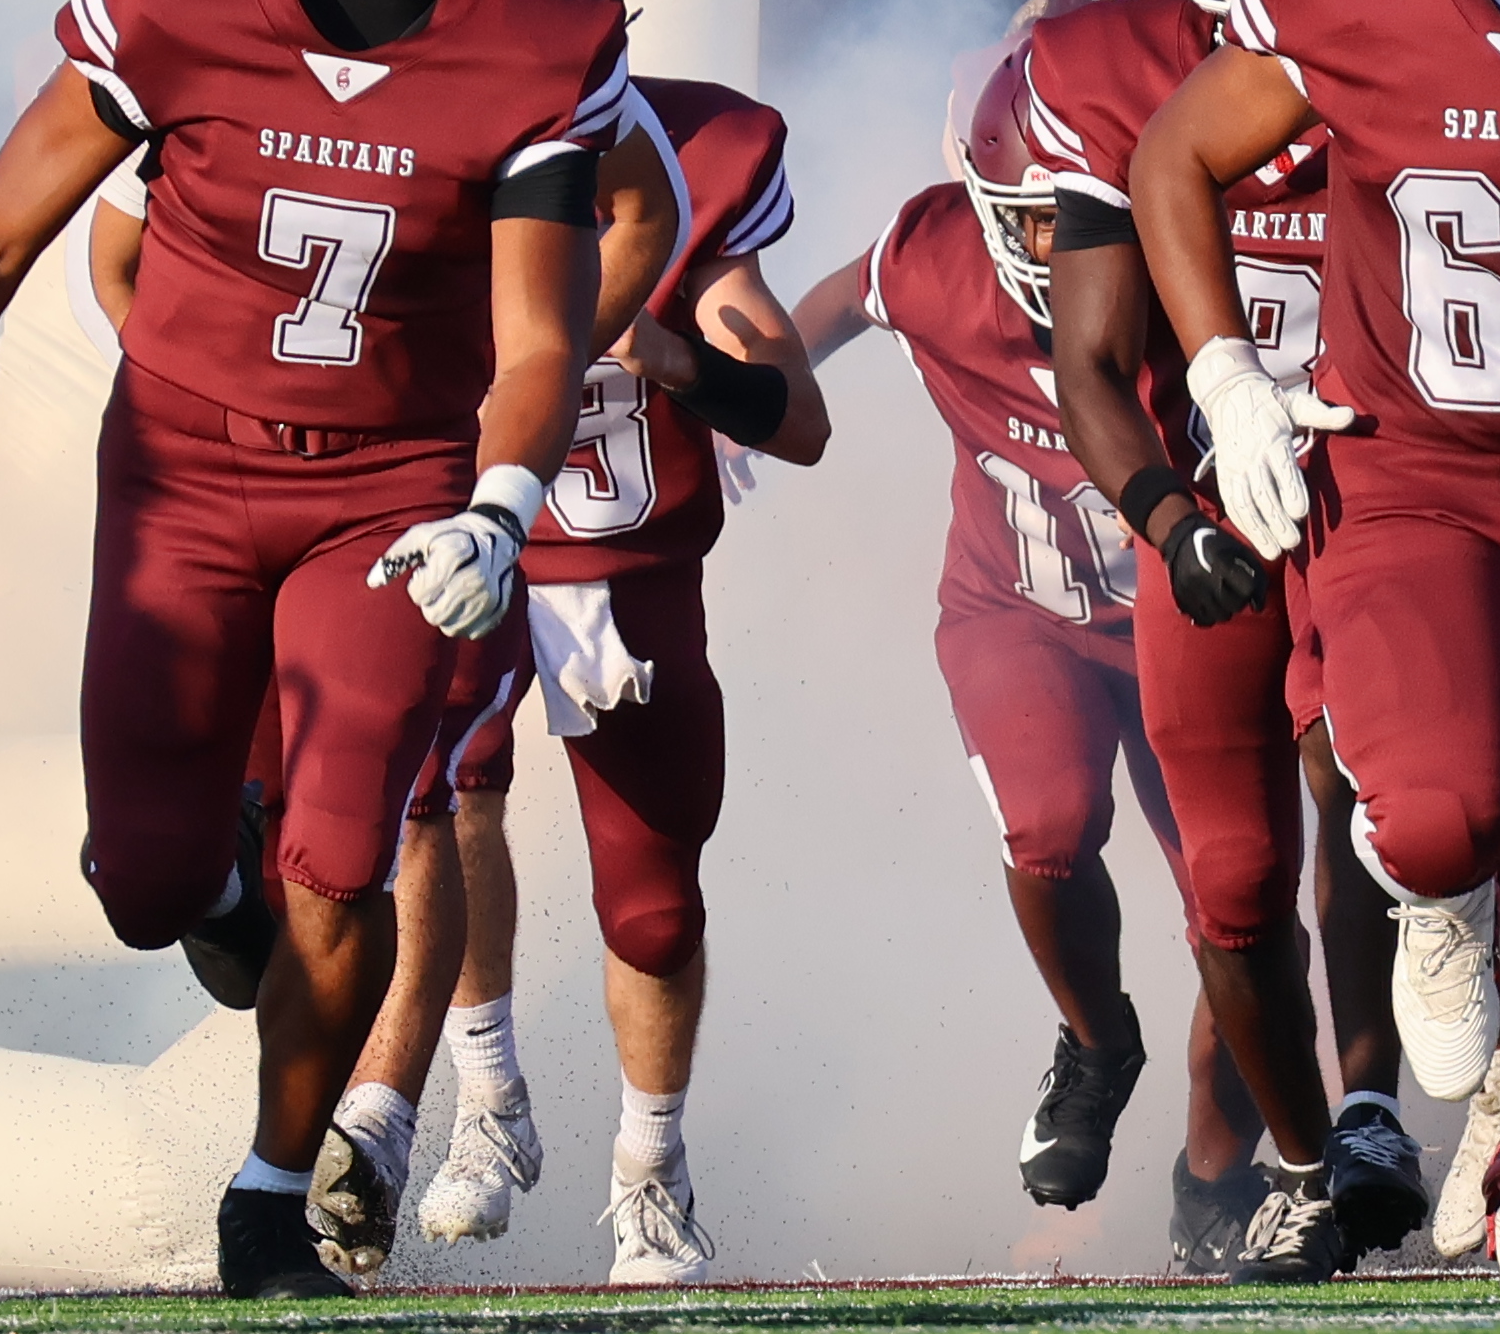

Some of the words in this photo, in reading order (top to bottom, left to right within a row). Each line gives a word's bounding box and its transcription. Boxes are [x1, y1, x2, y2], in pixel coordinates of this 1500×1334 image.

[259, 129, 415, 177] SPARTANS
[1230, 210, 1326, 242] ARTAN
[258, 187, 396, 365] 7
[1008, 417, 1069, 452] SPAR
